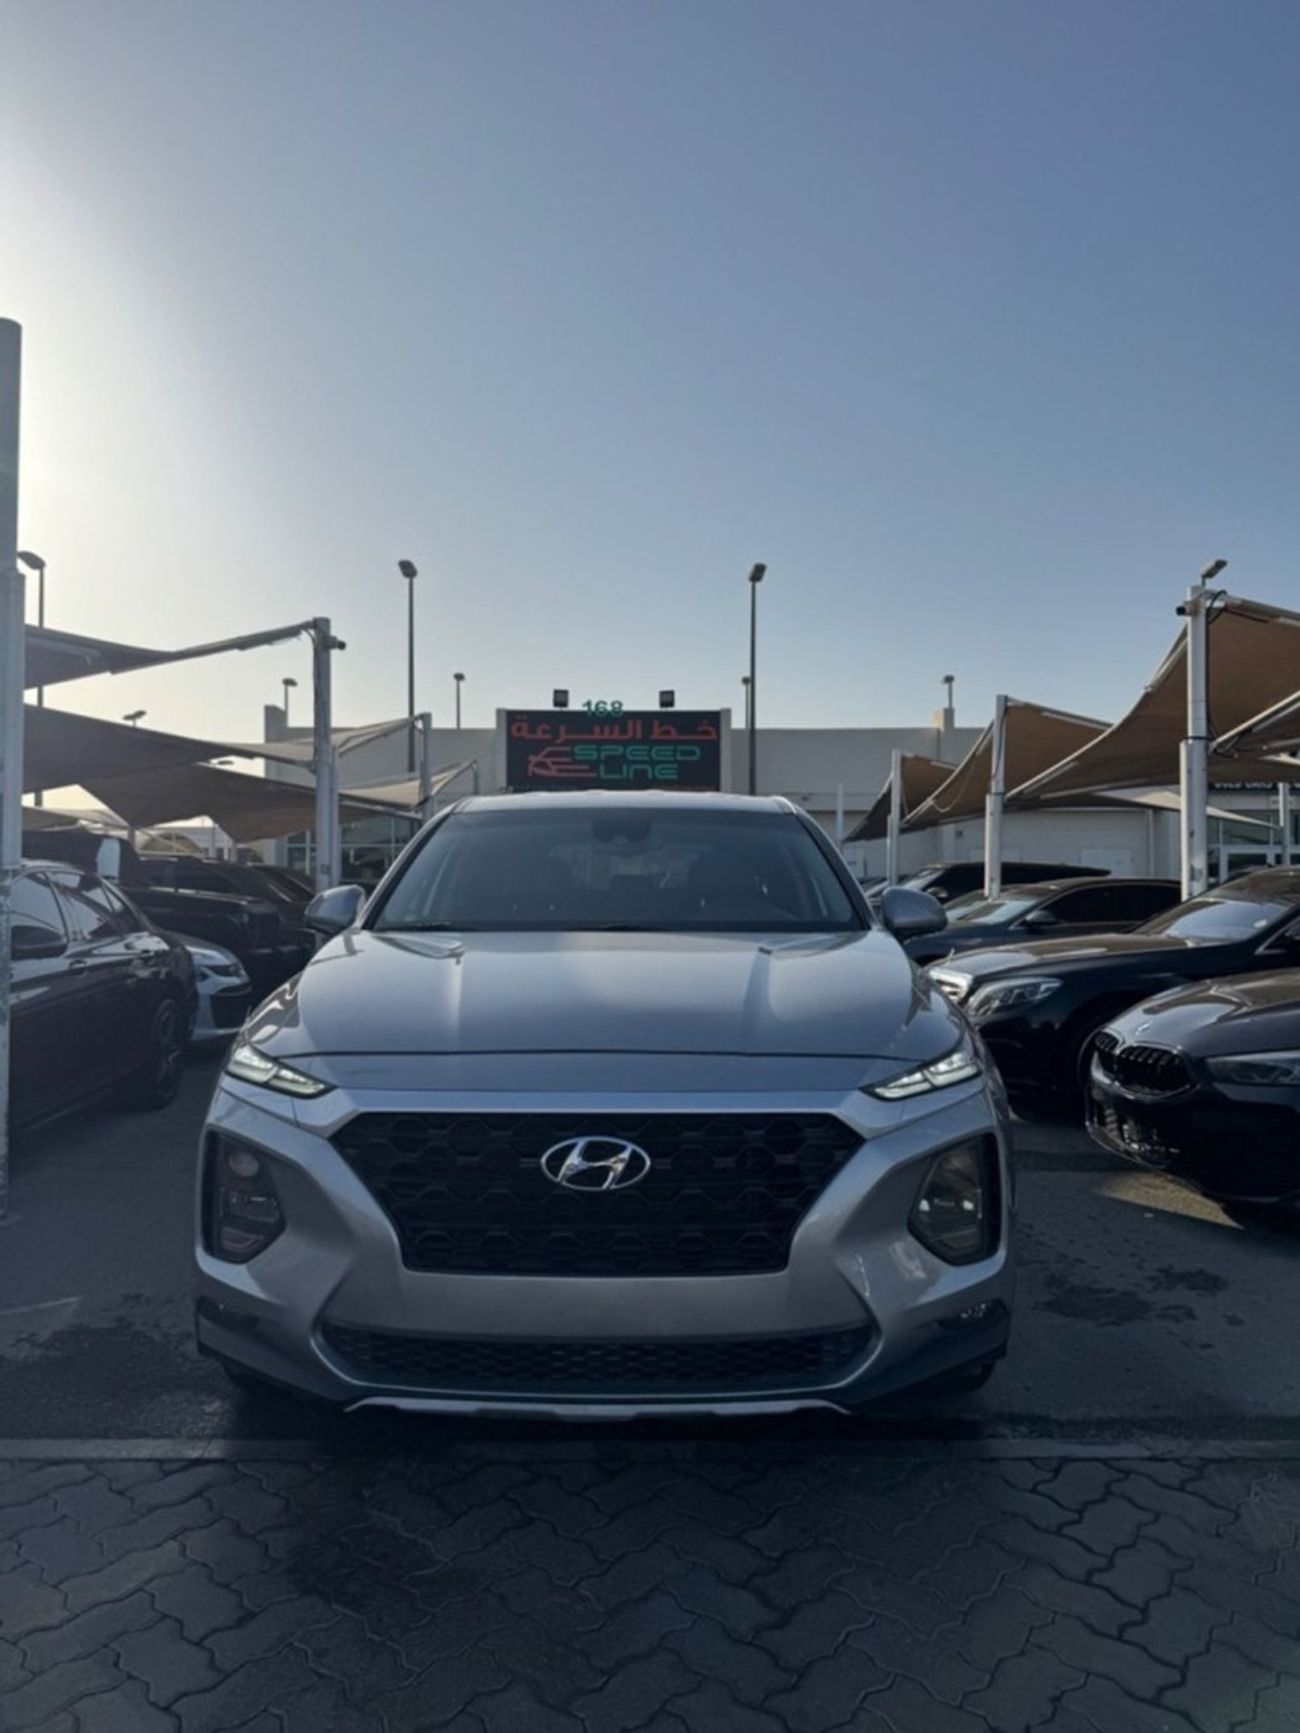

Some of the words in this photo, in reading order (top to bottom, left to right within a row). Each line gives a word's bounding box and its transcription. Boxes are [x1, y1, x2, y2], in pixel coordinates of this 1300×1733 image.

[583, 700, 624, 717] 168
[511, 715, 642, 743] السرعة
[651, 720, 718, 740] خط
[573, 745, 702, 761] SPEED
[600, 764, 679, 780] LINE
